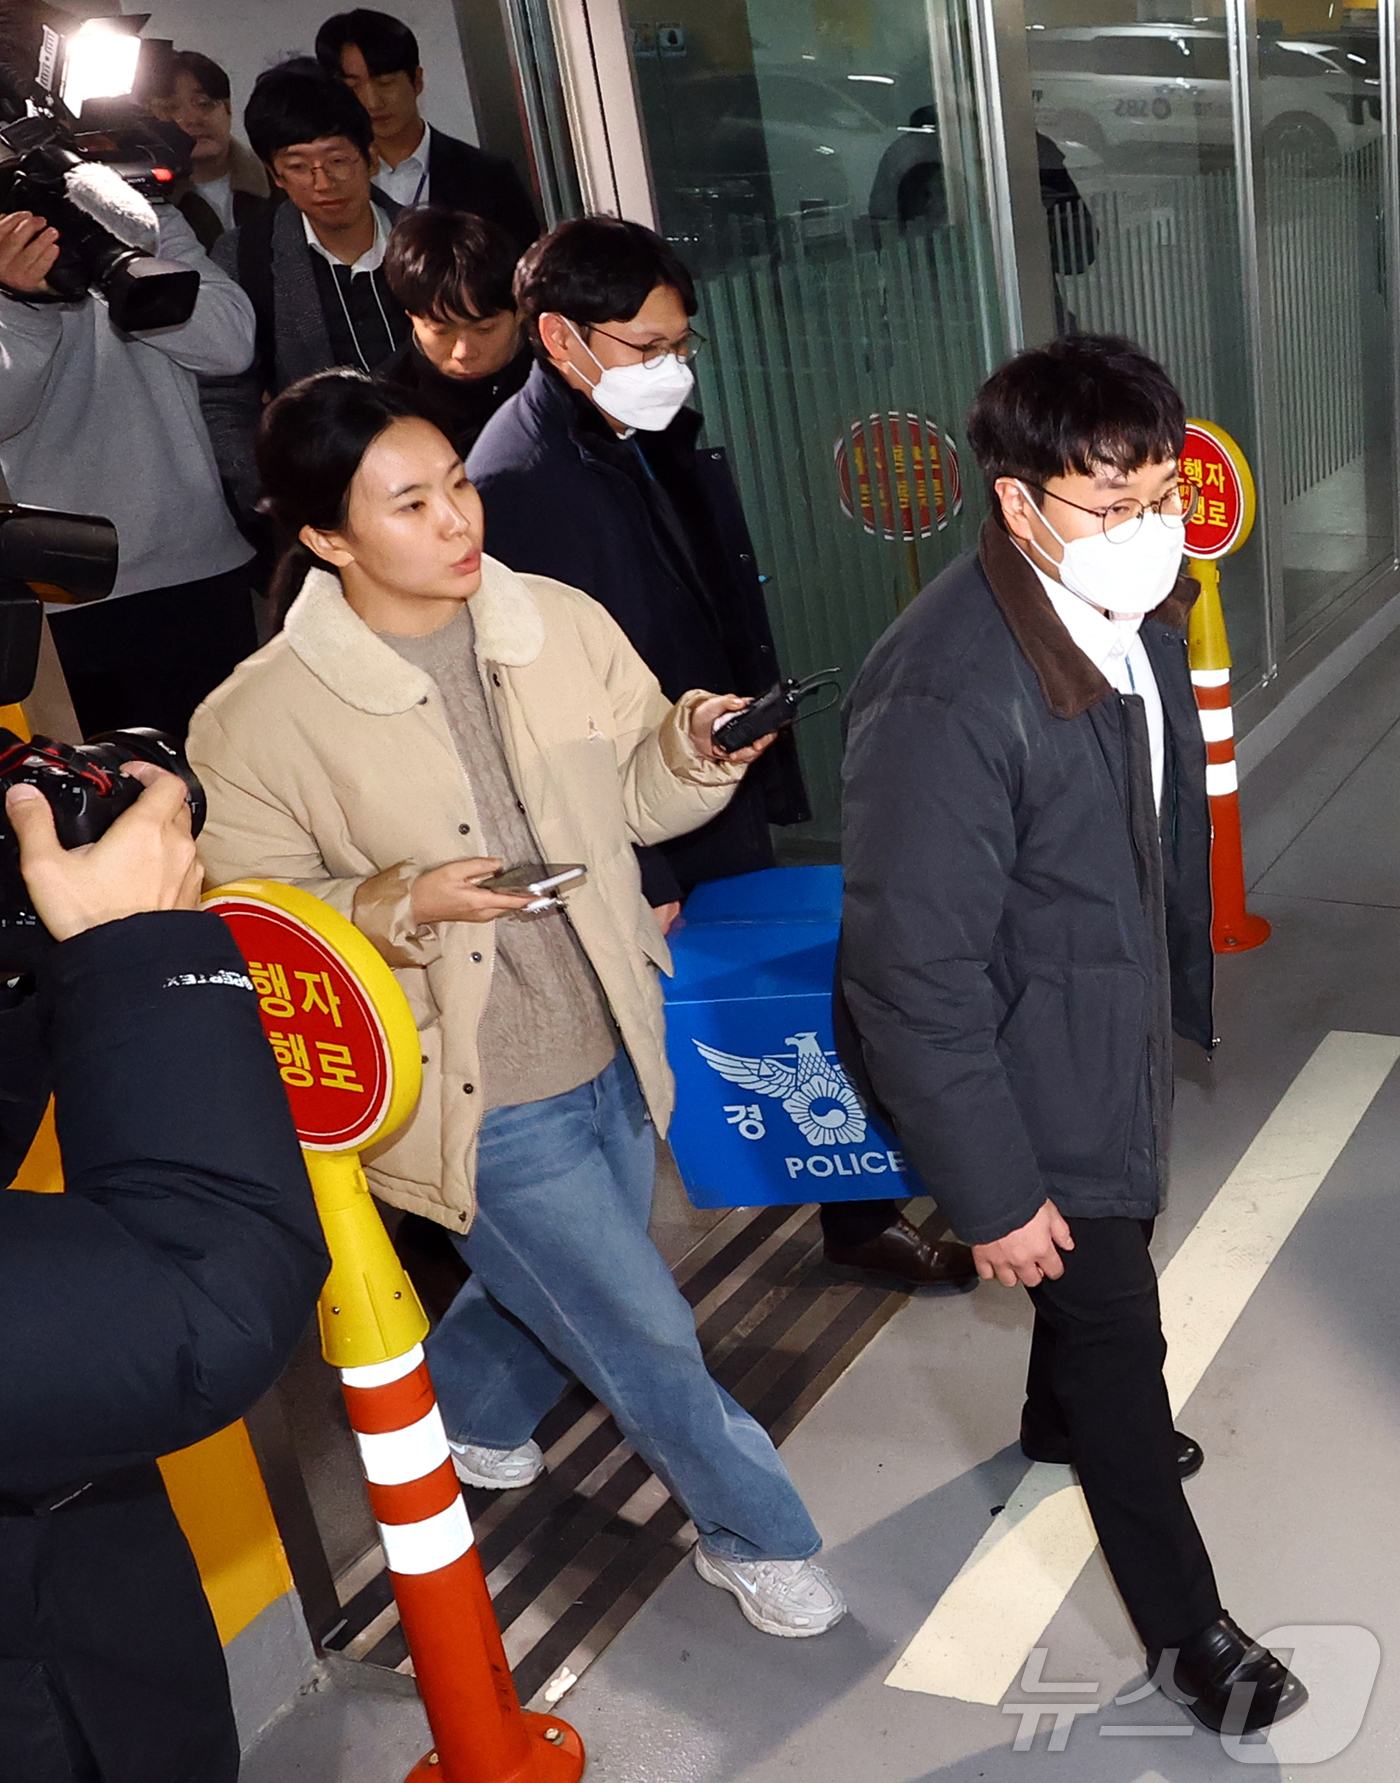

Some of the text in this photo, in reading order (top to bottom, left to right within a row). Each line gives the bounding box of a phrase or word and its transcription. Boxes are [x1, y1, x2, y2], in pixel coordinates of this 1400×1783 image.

[1190, 495, 1229, 528] 행로
[248, 960, 343, 1028] 행자
[268, 1030, 365, 1094] 행로
[784, 1150, 906, 1180] POLICE
